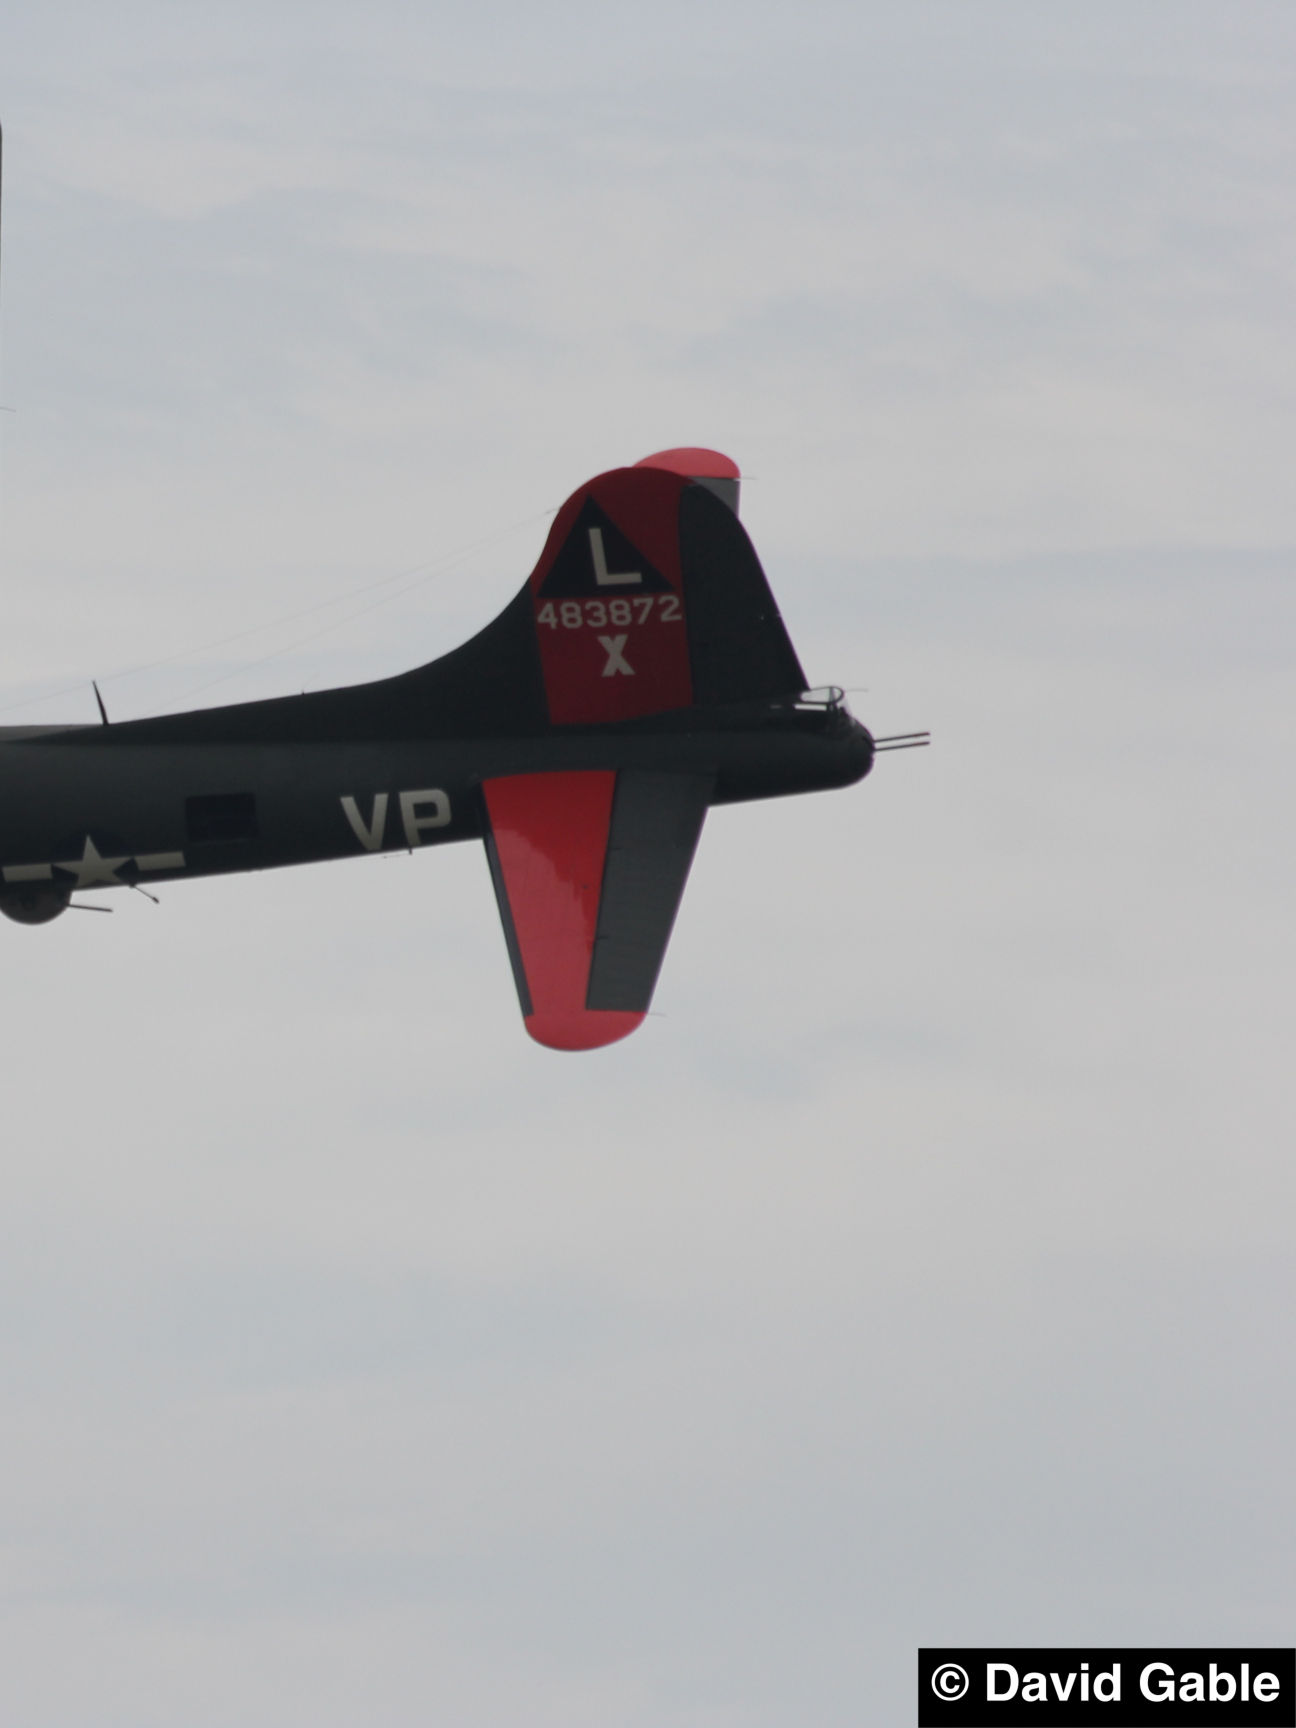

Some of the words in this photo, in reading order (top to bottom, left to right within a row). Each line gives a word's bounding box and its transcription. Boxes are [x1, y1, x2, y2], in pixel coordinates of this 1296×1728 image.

[589, 528, 642, 585] L
[537, 595, 682, 630] 483872
[598, 634, 635, 677] X
[341, 788, 452, 850] VP
